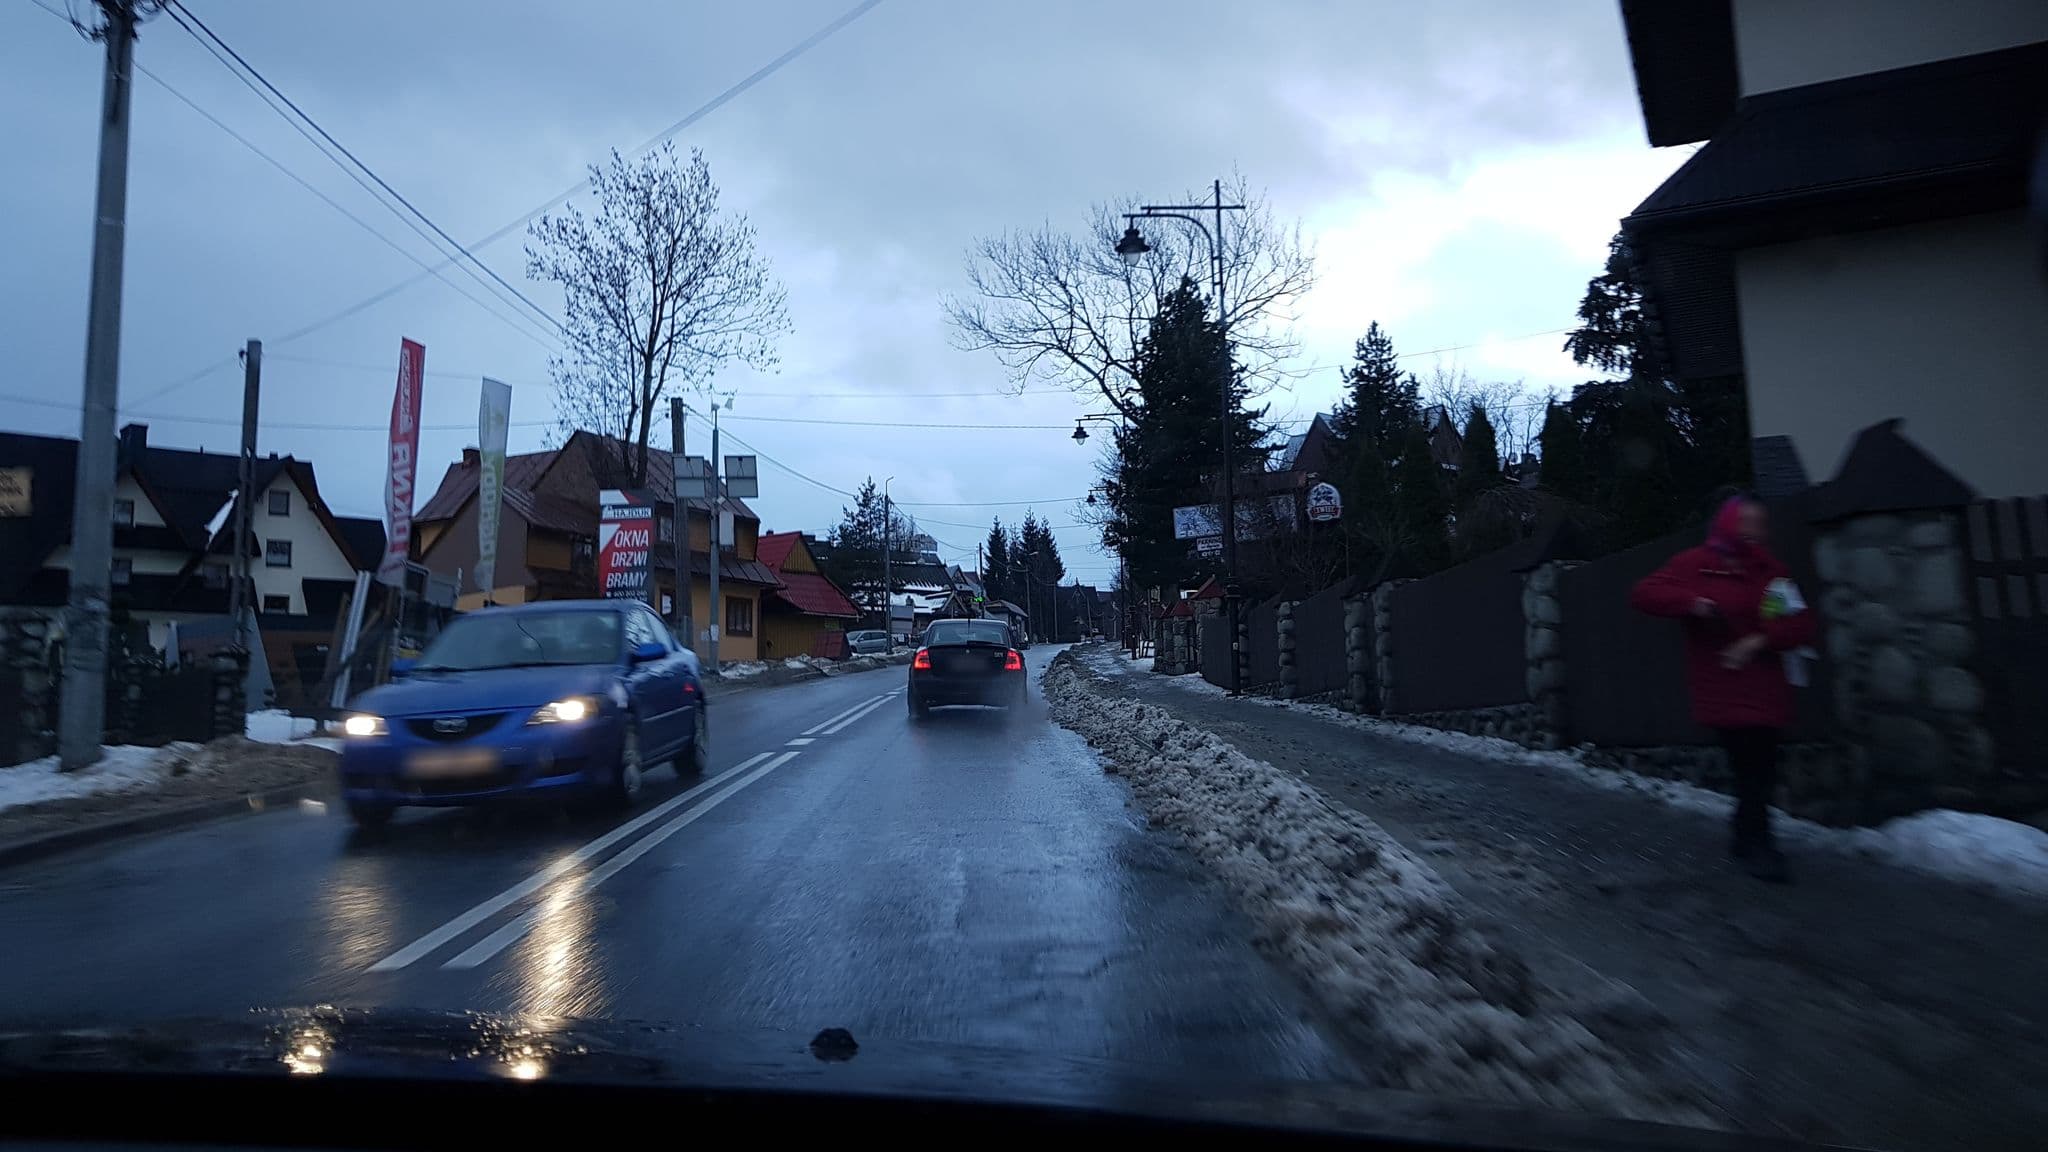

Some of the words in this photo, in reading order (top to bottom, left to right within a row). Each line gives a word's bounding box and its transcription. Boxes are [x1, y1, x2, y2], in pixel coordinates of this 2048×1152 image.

[614, 529, 649, 548] OKNA
[611, 550, 648, 568] DRZWI
[606, 571, 648, 588] BRAMY
